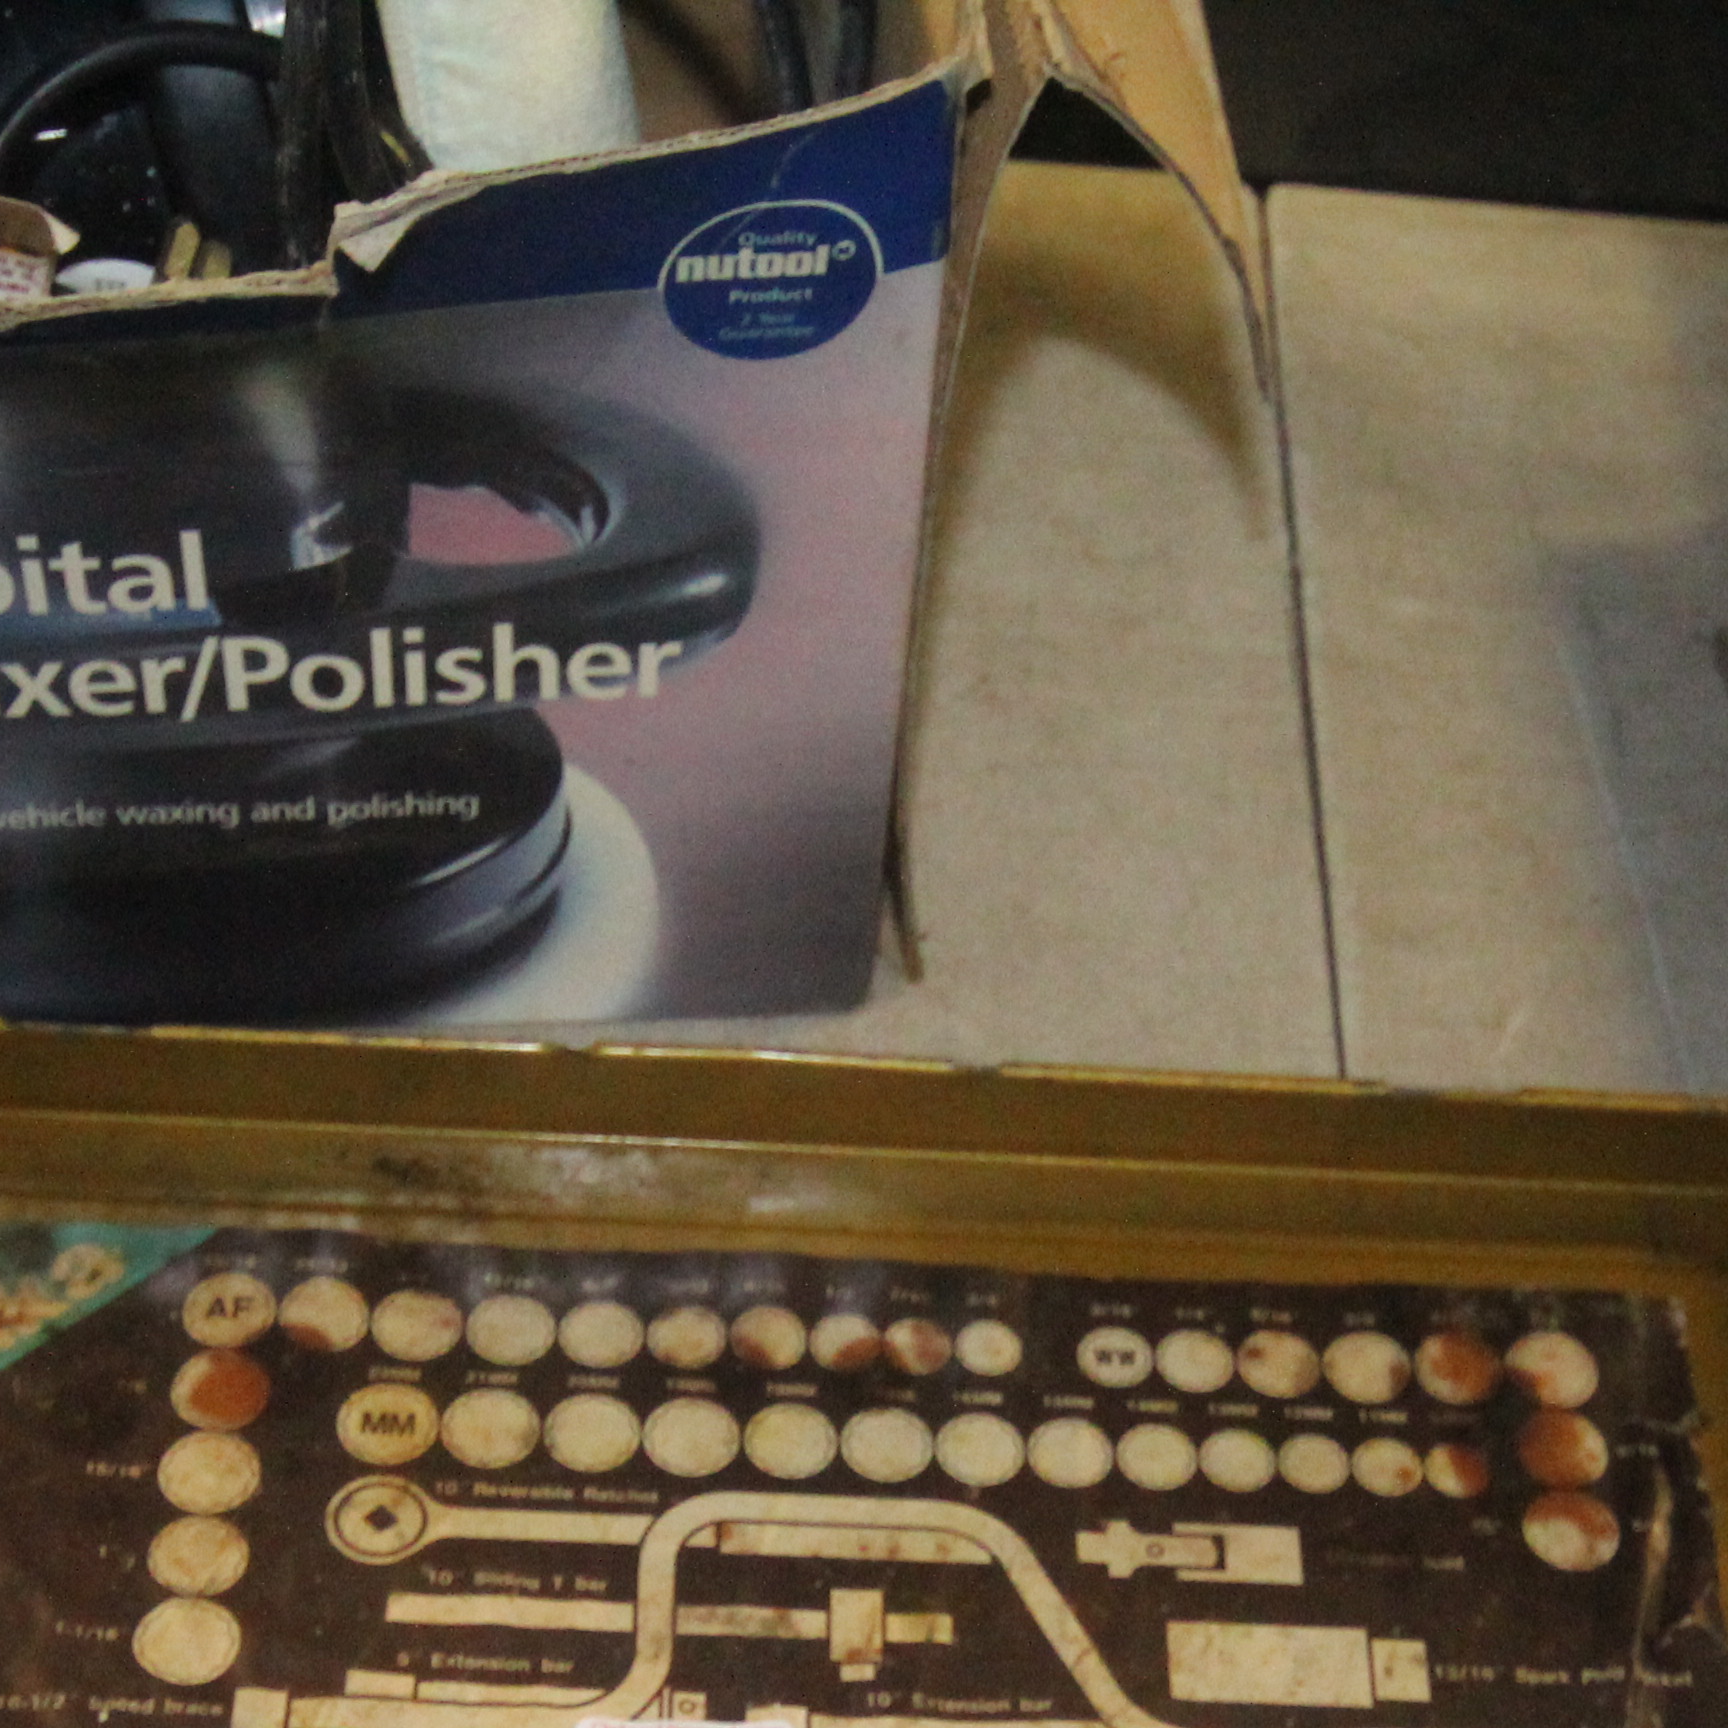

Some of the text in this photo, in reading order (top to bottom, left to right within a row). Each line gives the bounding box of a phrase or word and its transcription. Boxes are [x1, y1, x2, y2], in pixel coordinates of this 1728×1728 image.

[738, 231, 818, 247] Quality
[675, 244, 831, 283] nutool
[729, 288, 812, 304] Product
[116, 800, 240, 830] waxing
[251, 796, 316, 824] and
[327, 791, 480, 829] polishing
[205, 1297, 255, 1319] AF
[1094, 1350, 1136, 1366] WW
[360, 1411, 416, 1437] MM
[430, 1651, 531, 1672] Extension
